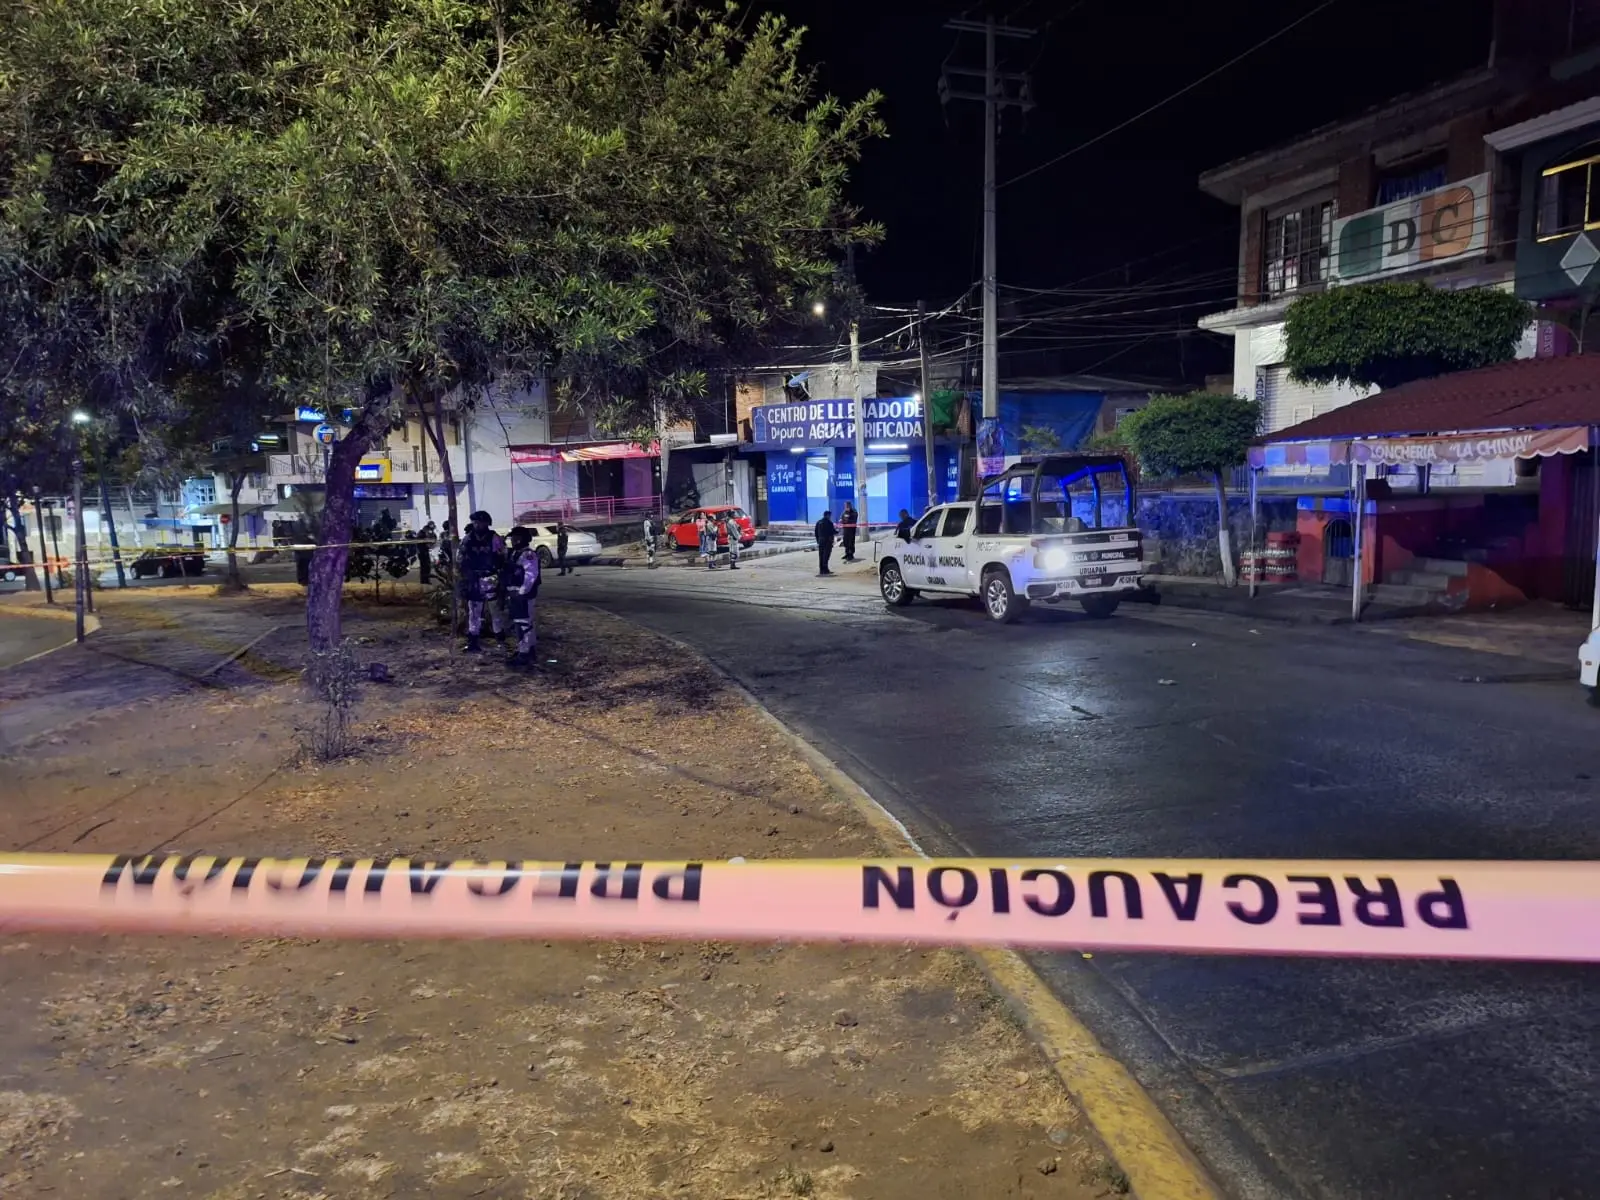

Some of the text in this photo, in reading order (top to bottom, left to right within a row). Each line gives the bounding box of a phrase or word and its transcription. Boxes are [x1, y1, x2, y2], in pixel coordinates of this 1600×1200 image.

[768, 405, 807, 424] CENTRO
[809, 403, 825, 421] DE
[904, 401, 924, 418] DE
[809, 422, 844, 440] AGUA
[847, 421, 923, 439] PRIFICADA
[1371, 443, 1437, 460] LONCHERIA
[1079, 565, 1107, 575] URUAPAN
[862, 864, 1471, 930] PRECAUCIÓN
